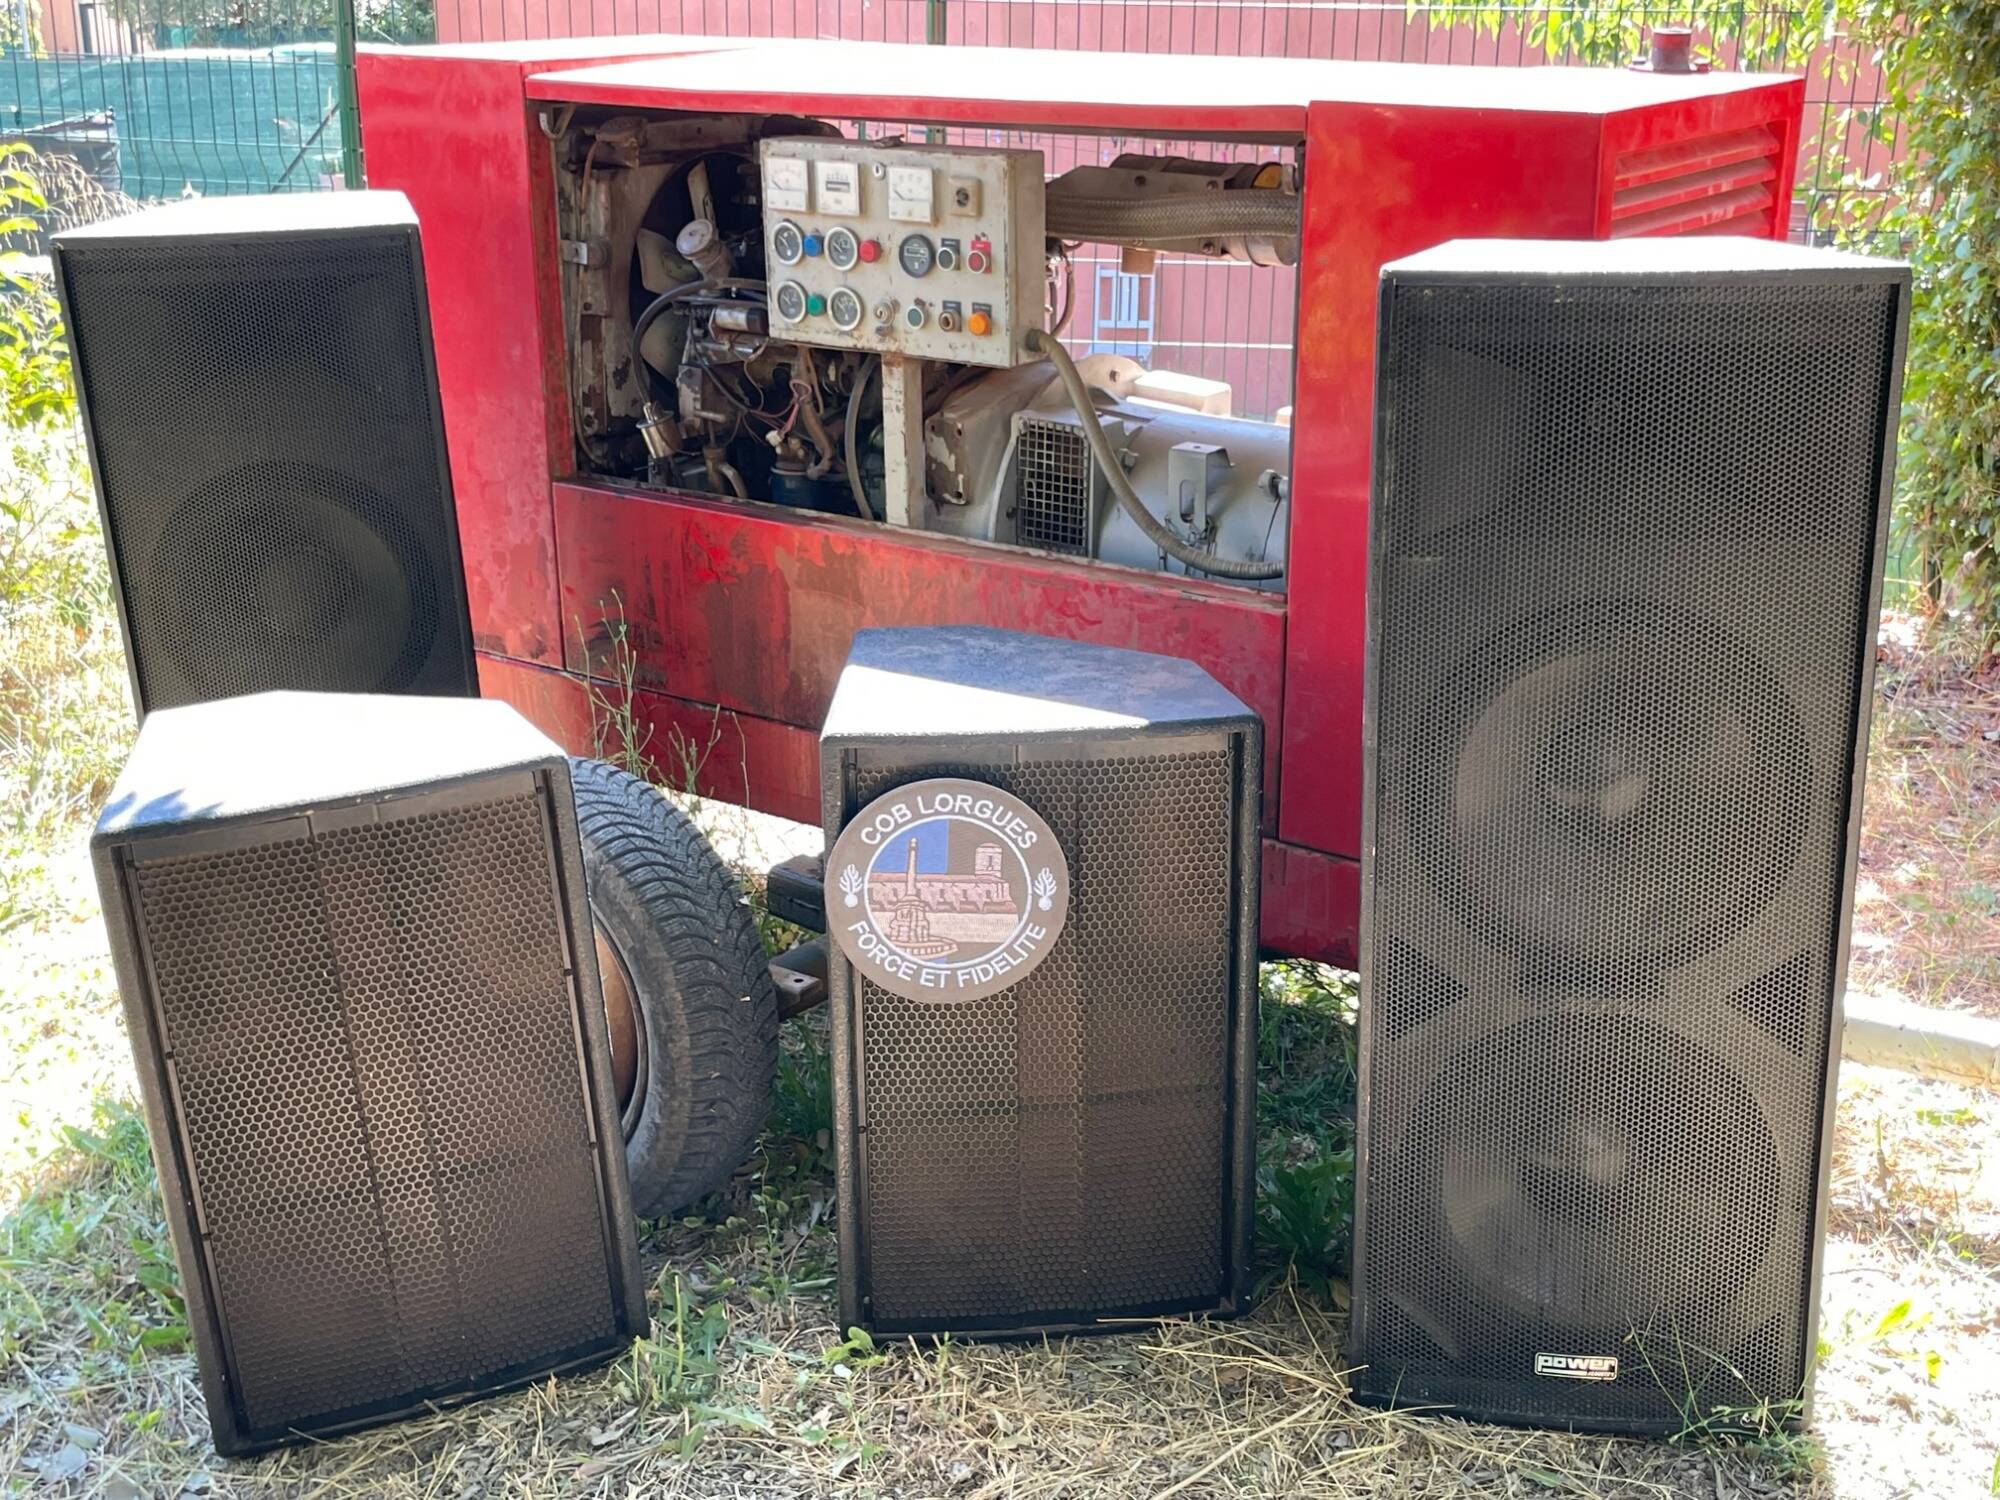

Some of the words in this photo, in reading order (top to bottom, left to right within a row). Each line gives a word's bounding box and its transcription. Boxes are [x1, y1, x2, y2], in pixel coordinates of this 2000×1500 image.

[861, 803, 912, 846] COB
[917, 793, 1037, 850] LORGUES
[847, 920, 917, 981] FORCE
[920, 969, 951, 988] ET
[957, 922, 1046, 988] FIDELITE
[1538, 1355, 1615, 1372] power
